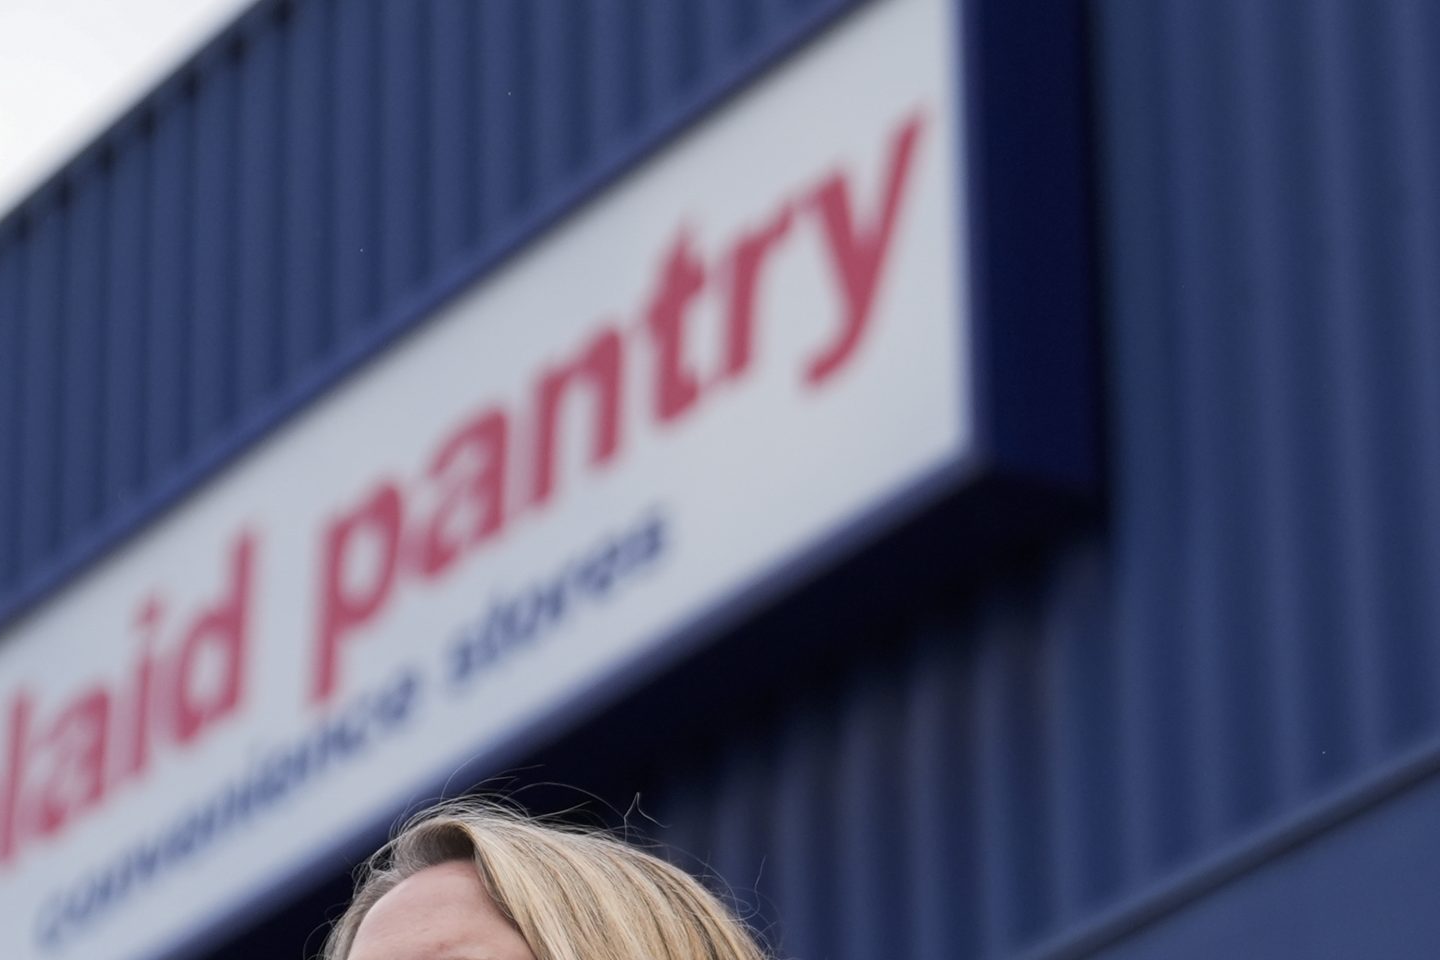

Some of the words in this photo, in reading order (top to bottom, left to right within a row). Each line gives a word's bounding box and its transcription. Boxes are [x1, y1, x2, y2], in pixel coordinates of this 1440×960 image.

[310, 108, 925, 708] pantry
[38, 668, 420, 946] convenience
[449, 510, 666, 686] stores
